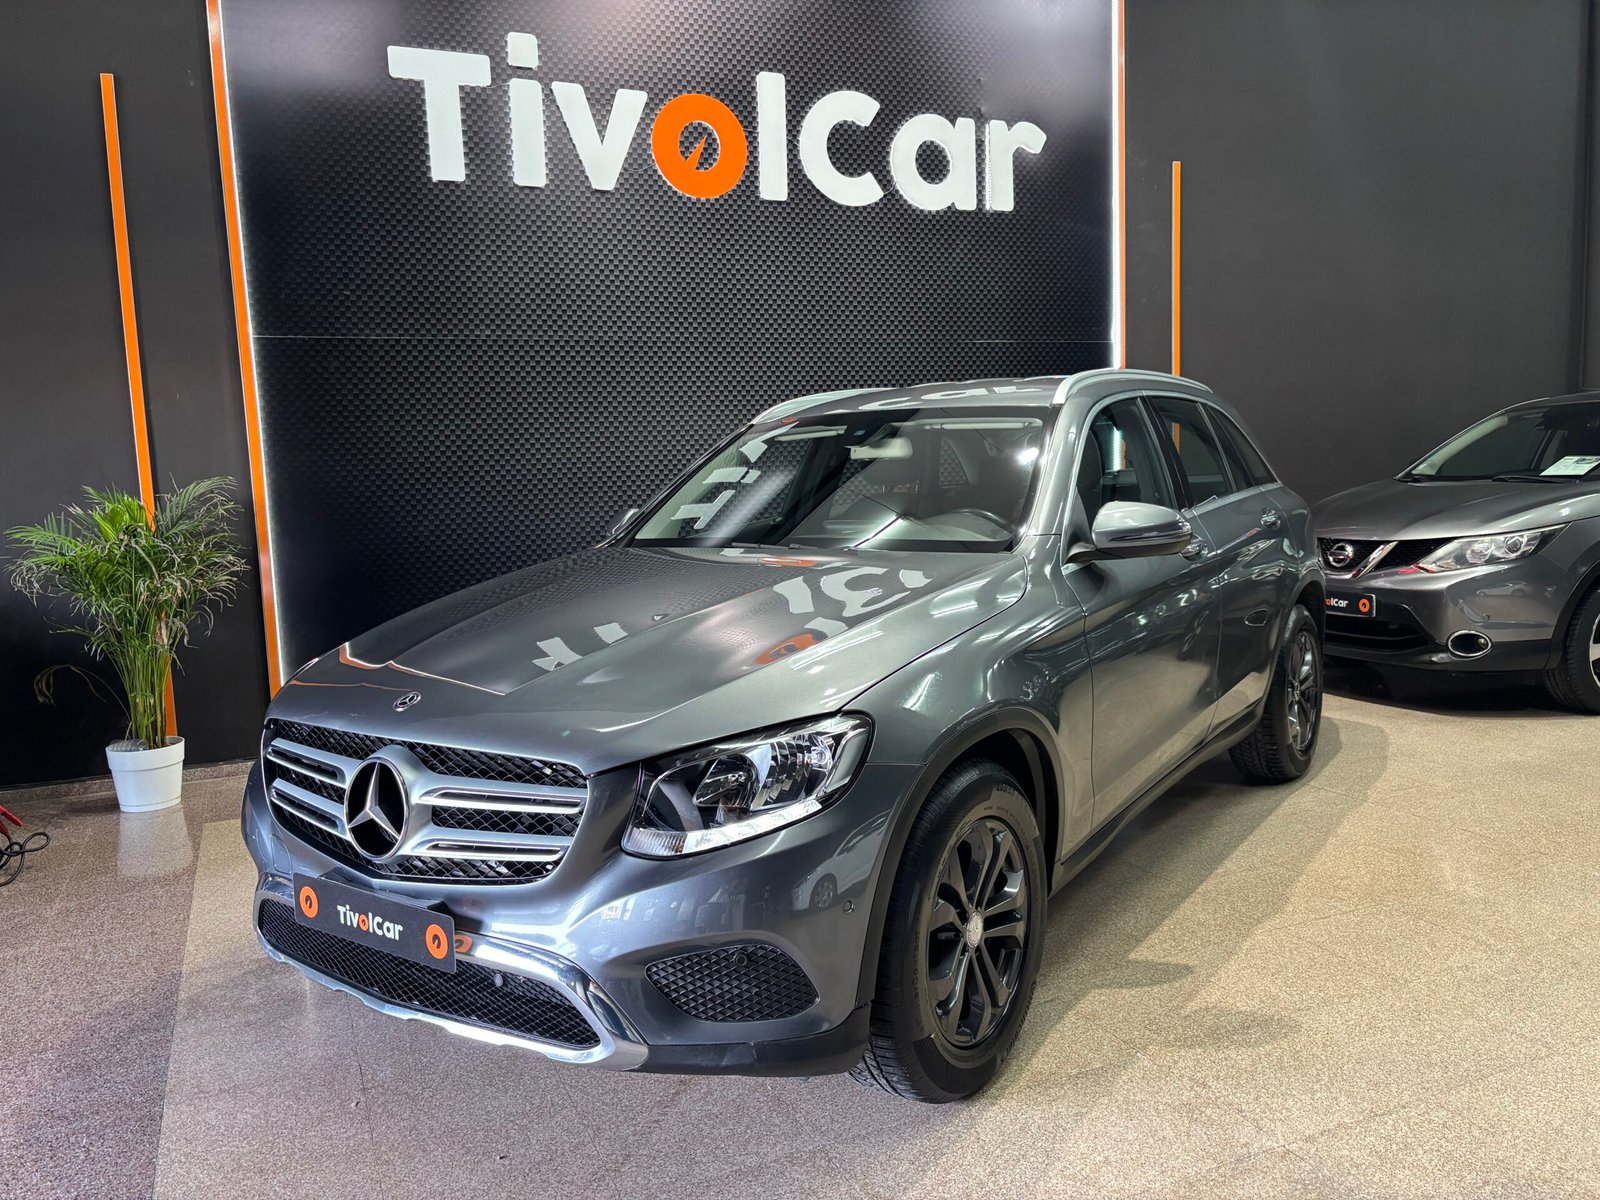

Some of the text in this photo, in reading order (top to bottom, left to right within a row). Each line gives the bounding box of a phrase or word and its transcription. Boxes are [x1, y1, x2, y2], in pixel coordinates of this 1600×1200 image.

[387, 31, 1047, 212] TivolCar
[1324, 597, 1349, 608] olCar
[337, 904, 404, 941] TivolCar
